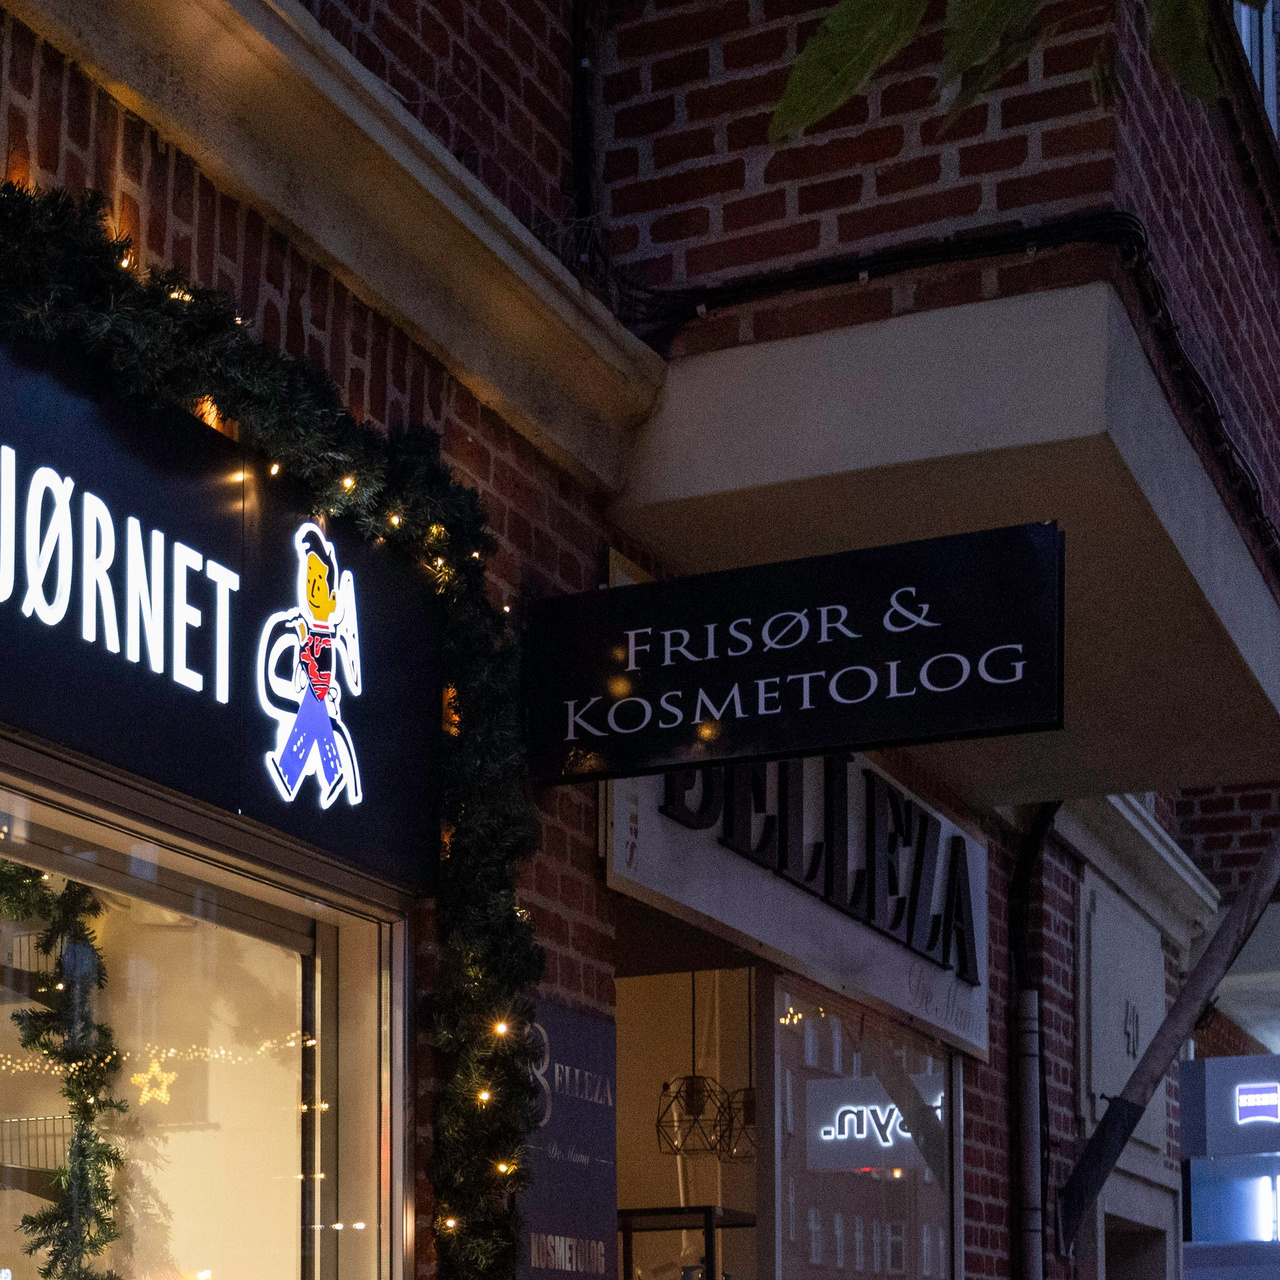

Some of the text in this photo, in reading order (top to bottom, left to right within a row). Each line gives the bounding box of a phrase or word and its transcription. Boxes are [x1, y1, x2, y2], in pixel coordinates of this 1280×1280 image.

[623, 586, 942, 673] FRISØR &
[563, 644, 1028, 742] KOSMETOLOG
[530, 1231, 605, 1274] KOSMETOLOG
